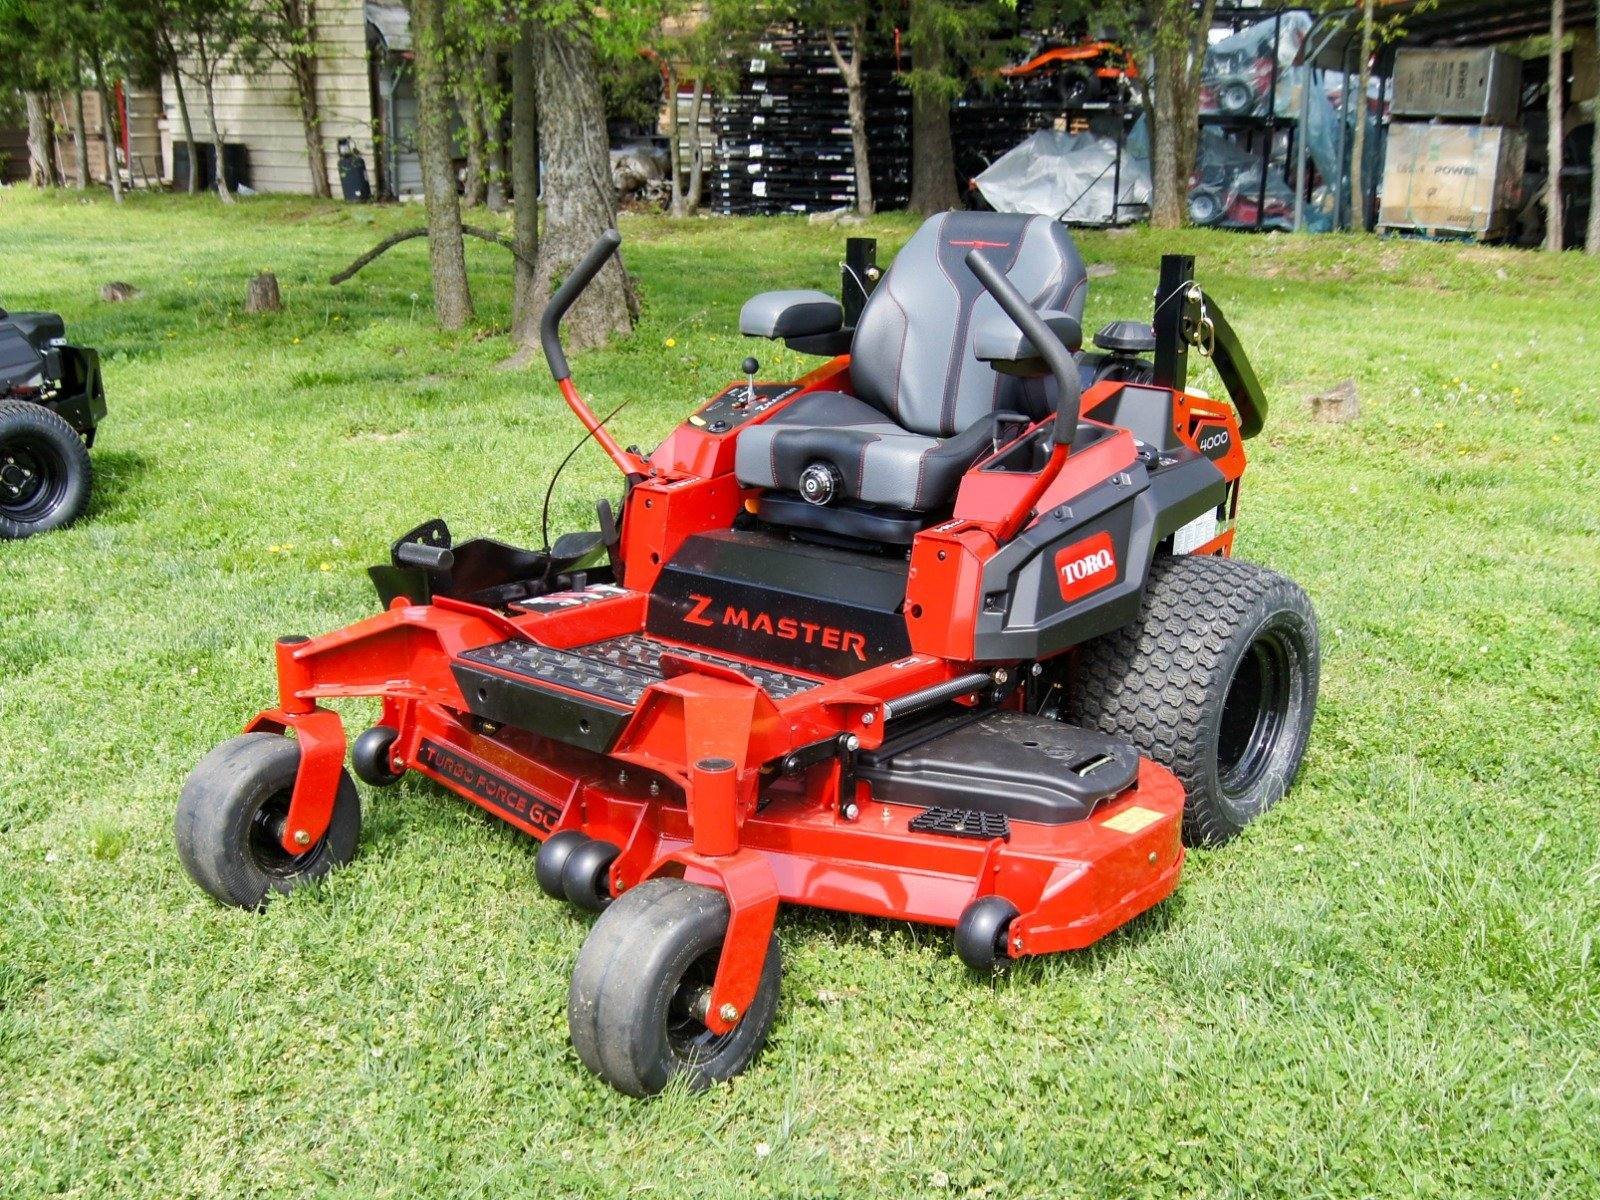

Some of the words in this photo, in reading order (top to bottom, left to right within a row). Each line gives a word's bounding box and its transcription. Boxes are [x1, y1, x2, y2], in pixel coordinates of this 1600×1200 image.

[1199, 430, 1229, 451] 4000
[683, 593, 715, 627] Z
[722, 605, 868, 662] MASTER
[427, 746, 474, 783] TURBO
[476, 774, 528, 813] FORCE
